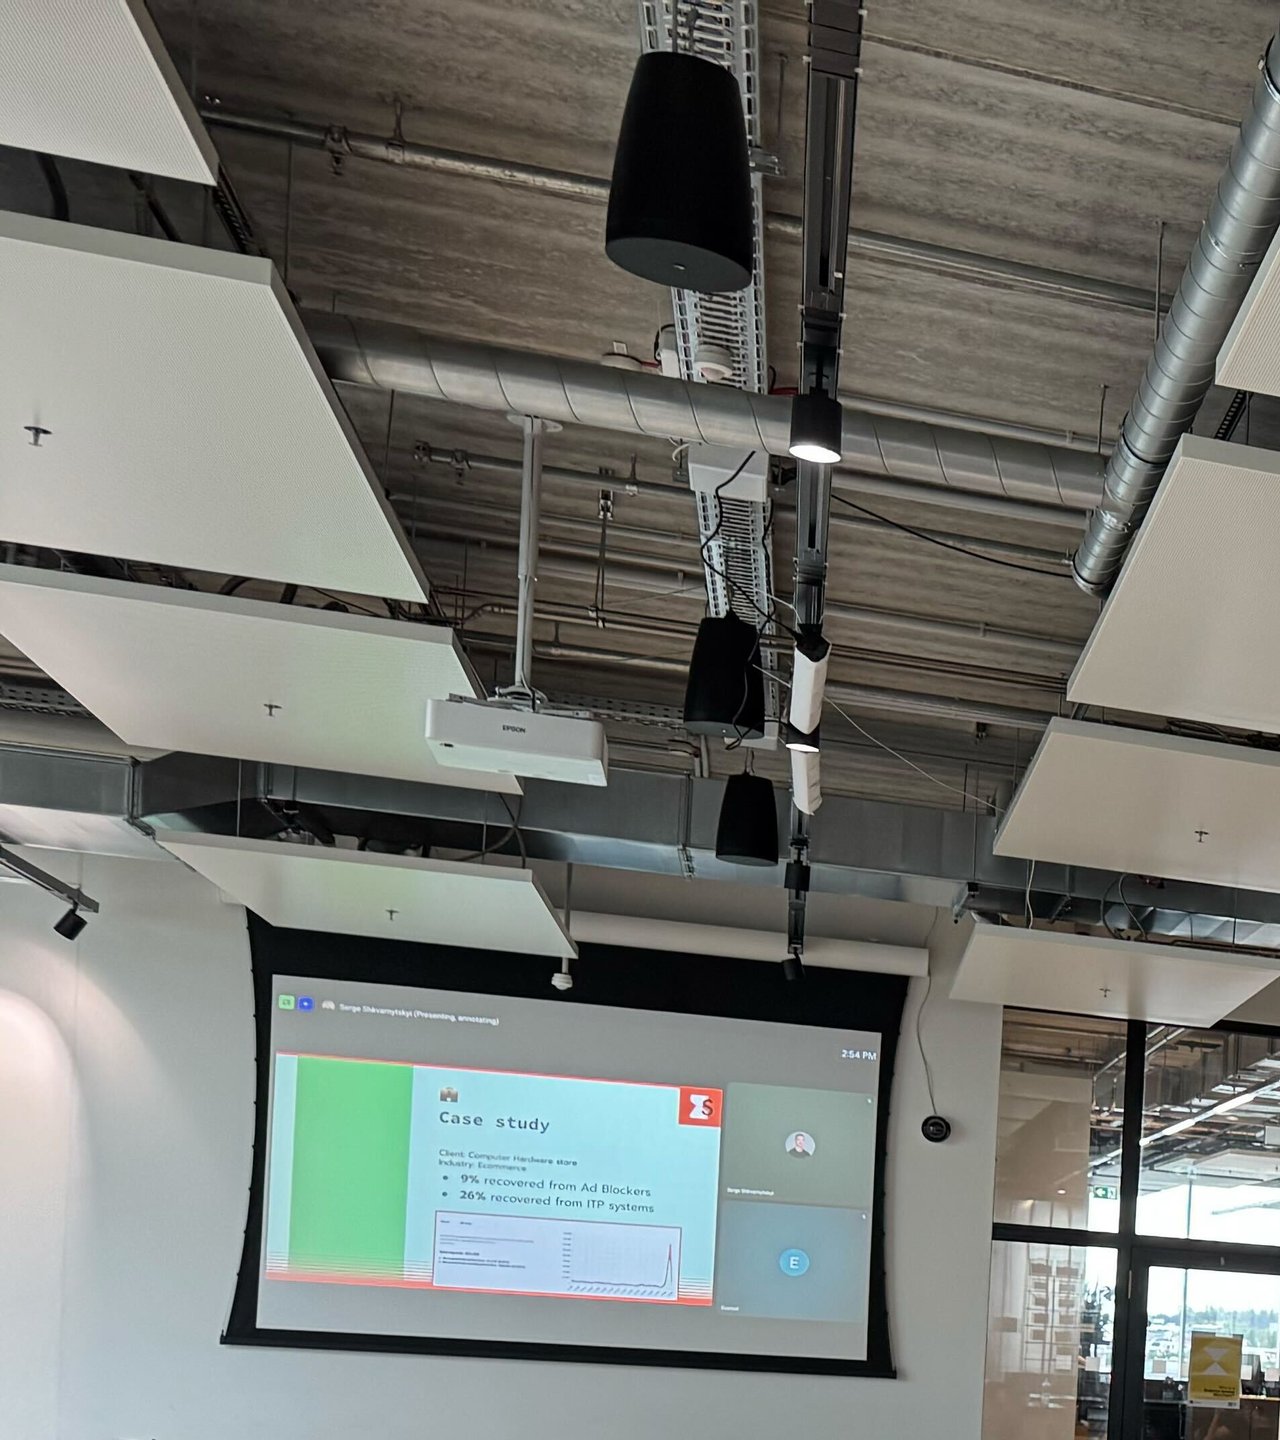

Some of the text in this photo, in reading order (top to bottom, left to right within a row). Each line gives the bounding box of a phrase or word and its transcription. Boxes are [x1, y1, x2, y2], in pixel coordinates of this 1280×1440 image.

[502, 724, 526, 734] EPSON
[841, 1049, 877, 1061] 2:54 PM
[439, 1111, 550, 1134] Case study
[468, 1151, 511, 1161] Computer
[513, 1155, 553, 1165] Hardware
[556, 1158, 577, 1167] store
[478, 1162, 527, 1172] Ecommerce
[461, 1174, 651, 1197] 9% recovered from Ad Blockers
[459, 1190, 654, 1213] 26% recovered from ITP systems
[789, 1257, 799, 1269] E
